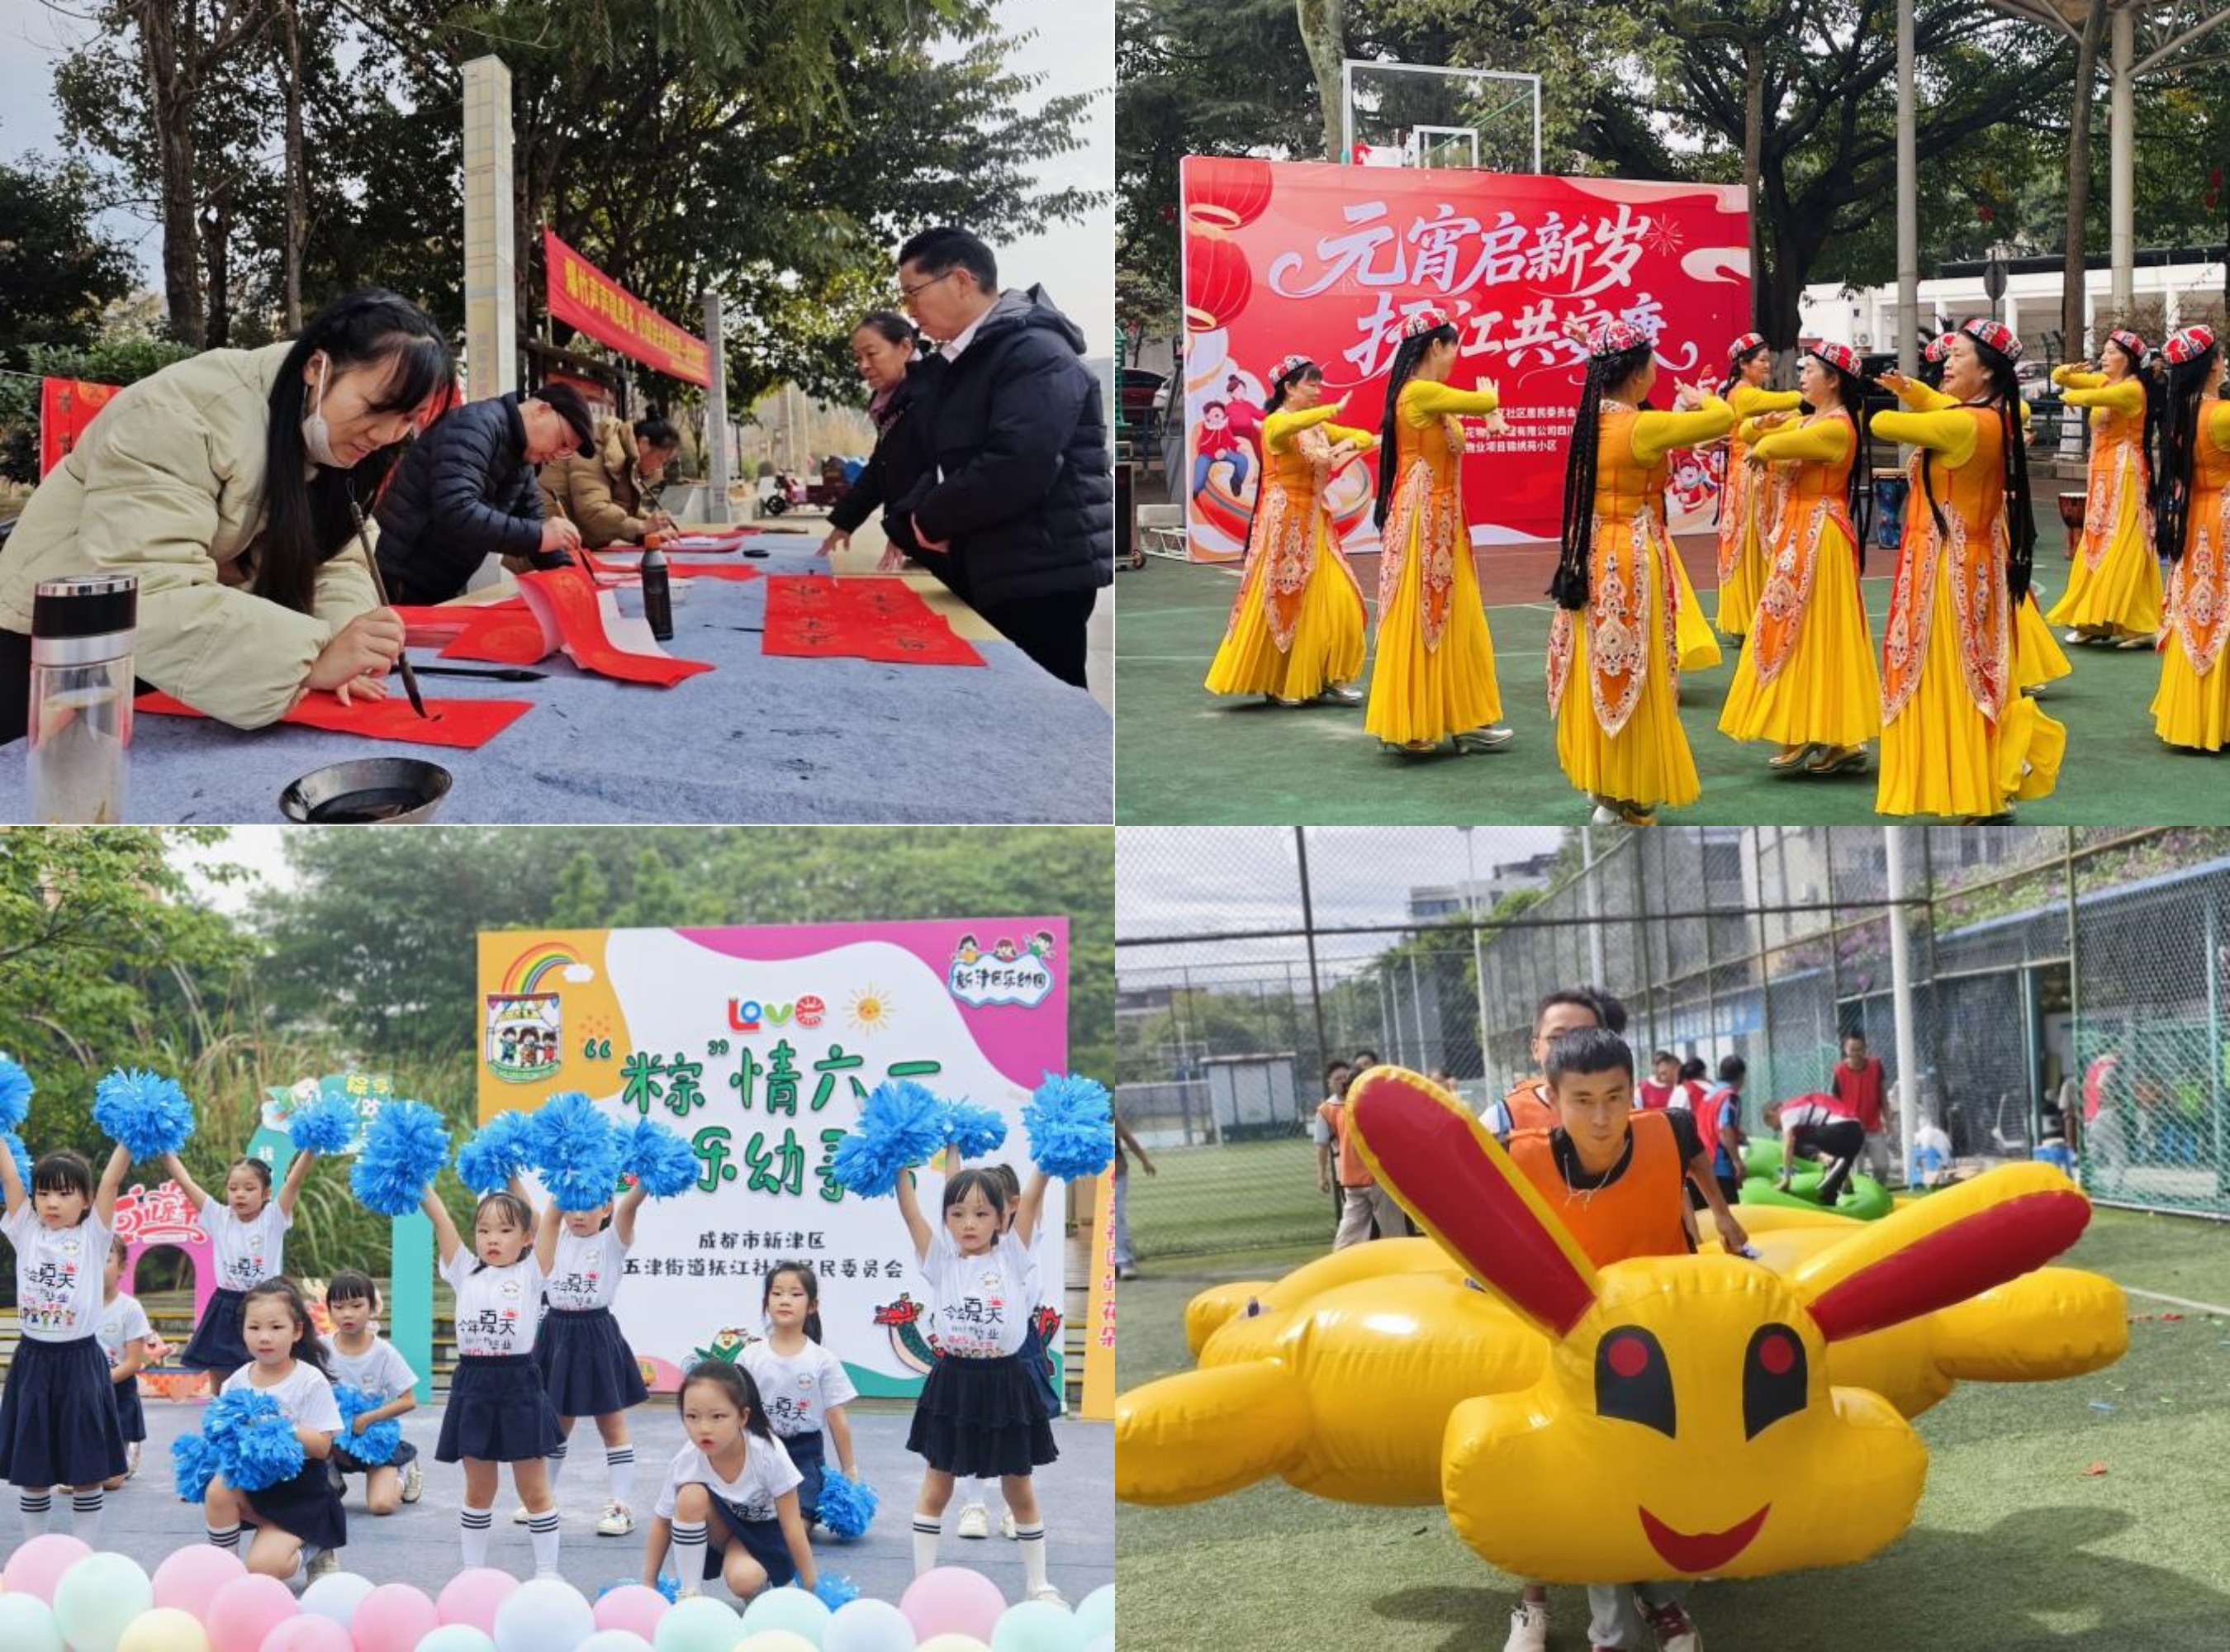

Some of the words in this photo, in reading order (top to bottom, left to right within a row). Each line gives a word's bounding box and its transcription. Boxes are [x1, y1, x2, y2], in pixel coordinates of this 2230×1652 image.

[1269, 202, 1651, 298] 元宵启新岁
[698, 1230, 827, 1250] 成都市新津区
[623, 1258, 904, 1278] 五津街道抚江社民委员会
